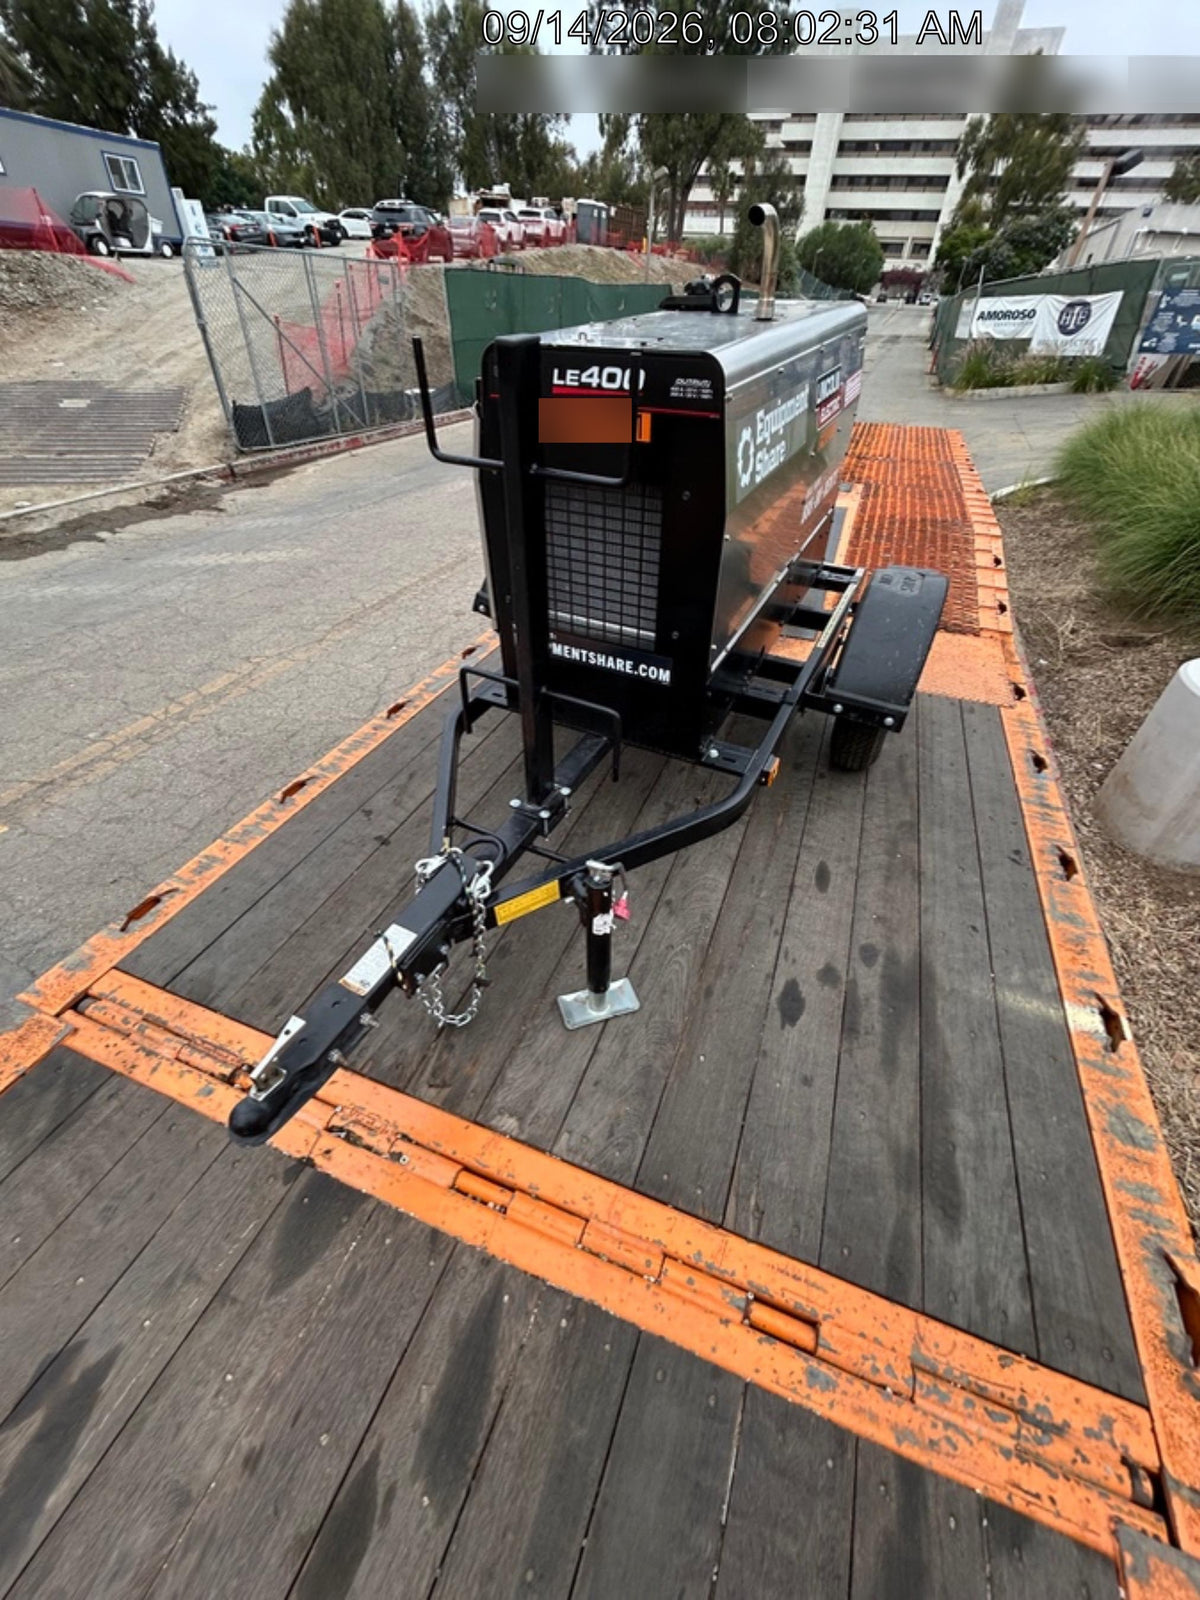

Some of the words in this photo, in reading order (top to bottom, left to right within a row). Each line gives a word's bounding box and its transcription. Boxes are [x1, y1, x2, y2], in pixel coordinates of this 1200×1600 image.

[977, 308, 1037, 321] AMOROSO
[756, 384, 809, 445] Equipment
[549, 642, 671, 683] MENTSHARE.COM
